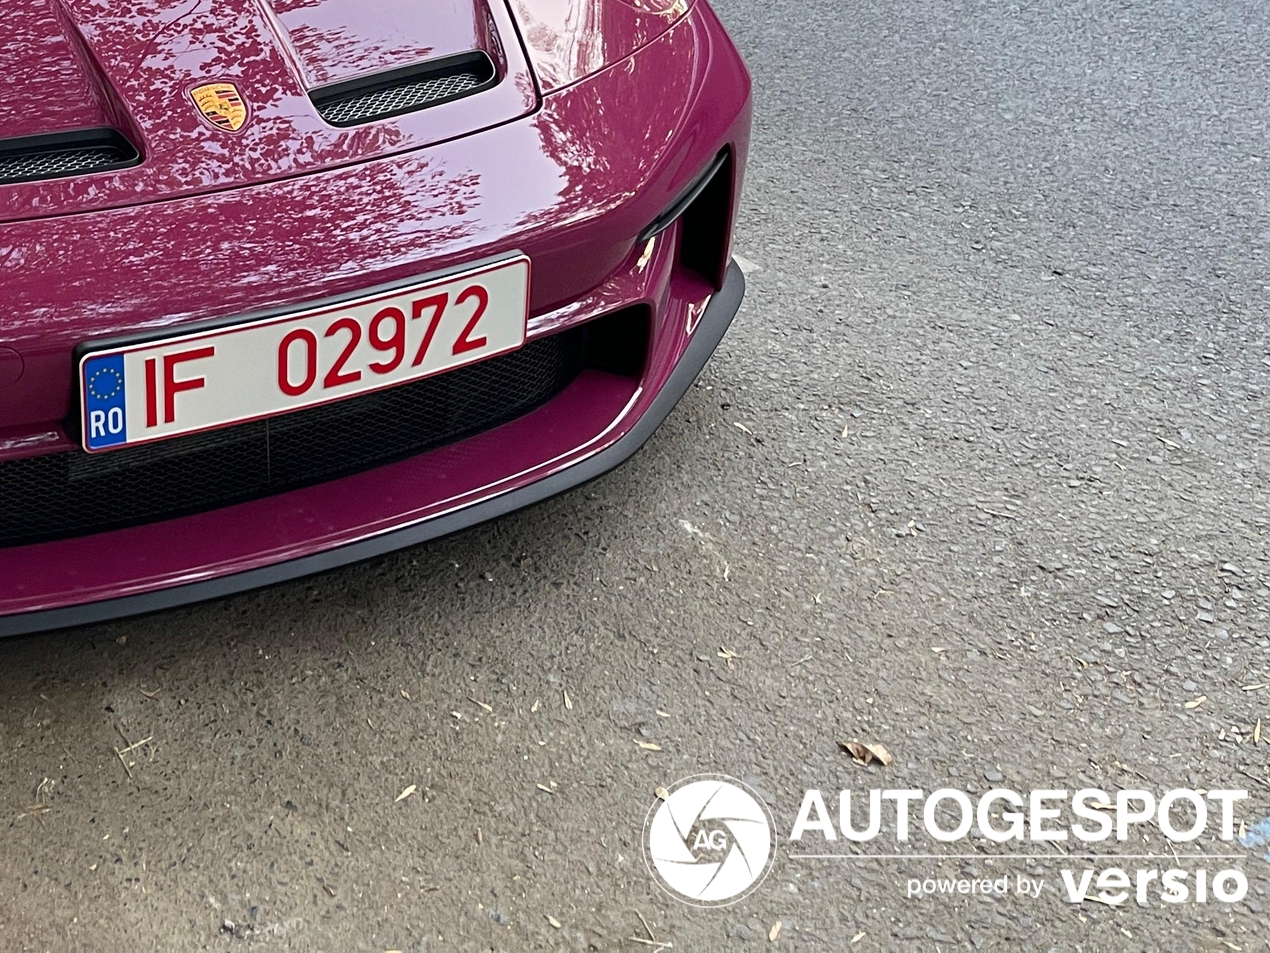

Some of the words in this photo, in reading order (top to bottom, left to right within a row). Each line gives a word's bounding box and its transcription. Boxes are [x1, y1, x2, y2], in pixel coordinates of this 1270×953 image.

[144, 346, 215, 428] IF
[276, 285, 489, 397] 02972
[90, 407, 124, 438] RO
